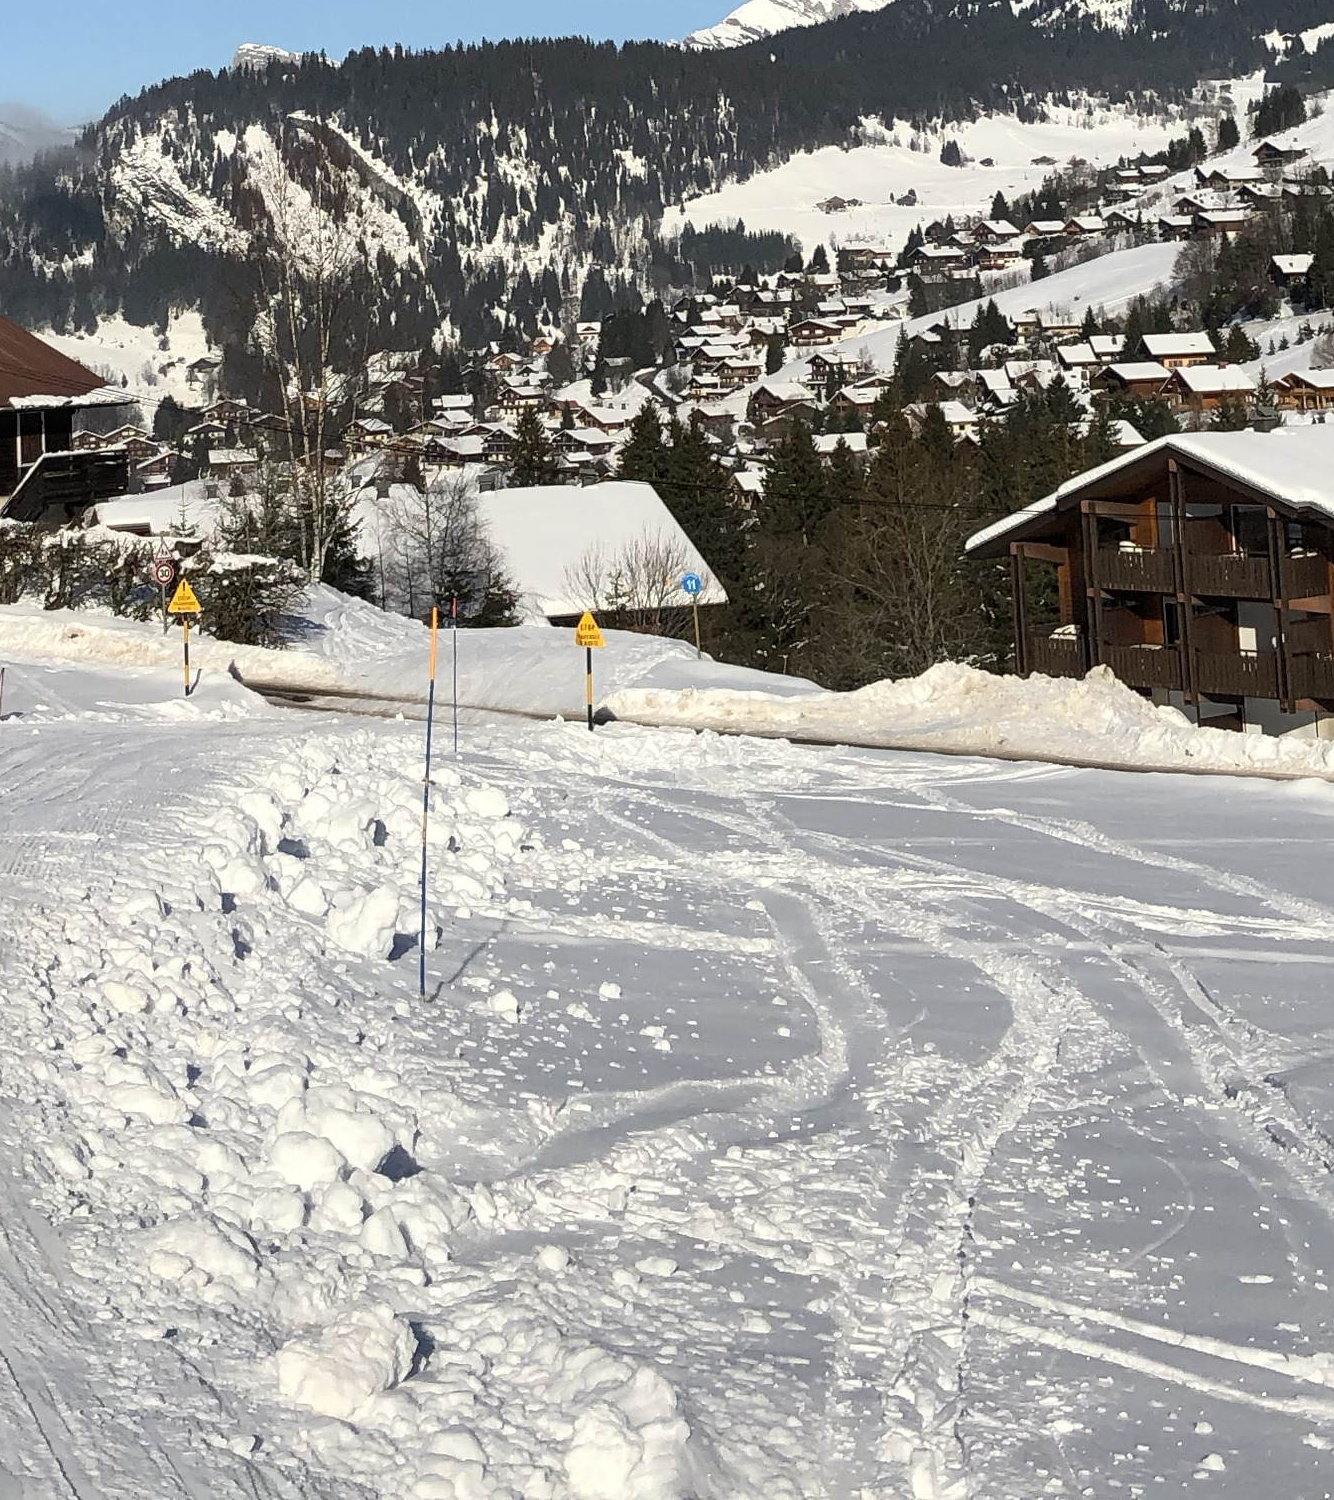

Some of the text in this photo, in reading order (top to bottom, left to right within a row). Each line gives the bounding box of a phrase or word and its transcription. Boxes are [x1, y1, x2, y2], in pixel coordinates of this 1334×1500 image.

[160, 569, 170, 578] 30
[686, 579, 697, 590] 11
[580, 623, 596, 631] STOP
